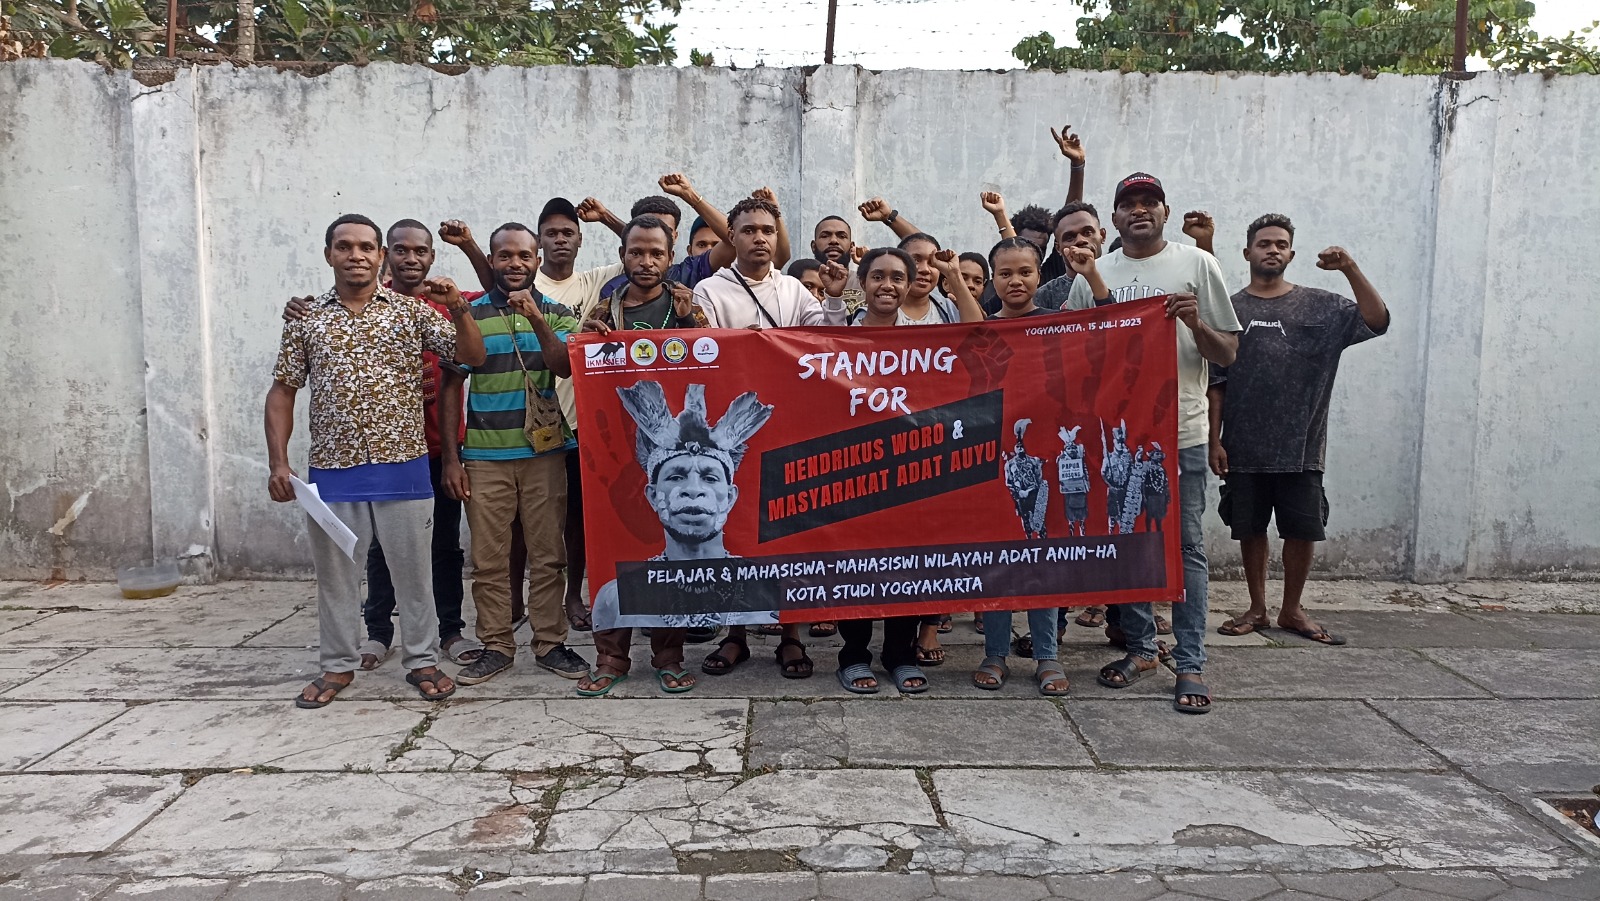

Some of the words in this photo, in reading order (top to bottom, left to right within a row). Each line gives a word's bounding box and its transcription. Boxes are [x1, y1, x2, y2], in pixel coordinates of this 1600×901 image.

[1088, 322, 1096, 330] 15
[1098, 320, 1117, 329] JULI
[1119, 317, 1141, 327] 2023
[798, 347, 958, 380] STANDING
[849, 386, 912, 416] FOR
[784, 438, 885, 485] HENDRIKUS
[891, 422, 944, 456] WORO
[952, 419, 964, 440] &
[768, 469, 889, 522] MASYARAKAT
[897, 454, 943, 487] ADAT
[950, 440, 997, 473] AUYU
[647, 567, 717, 584] PELAJAR
[720, 567, 732, 582] &
[736, 555, 919, 581] MAHASISWA-MAHASISWI
[924, 551, 994, 569] WILAYAH
[998, 547, 1042, 564] ADAT
[1046, 543, 1118, 563] ANIM-HA
[786, 585, 827, 602] KOTA
[833, 582, 875, 599] STUDI
[880, 576, 983, 597] YOGYAKARTA
